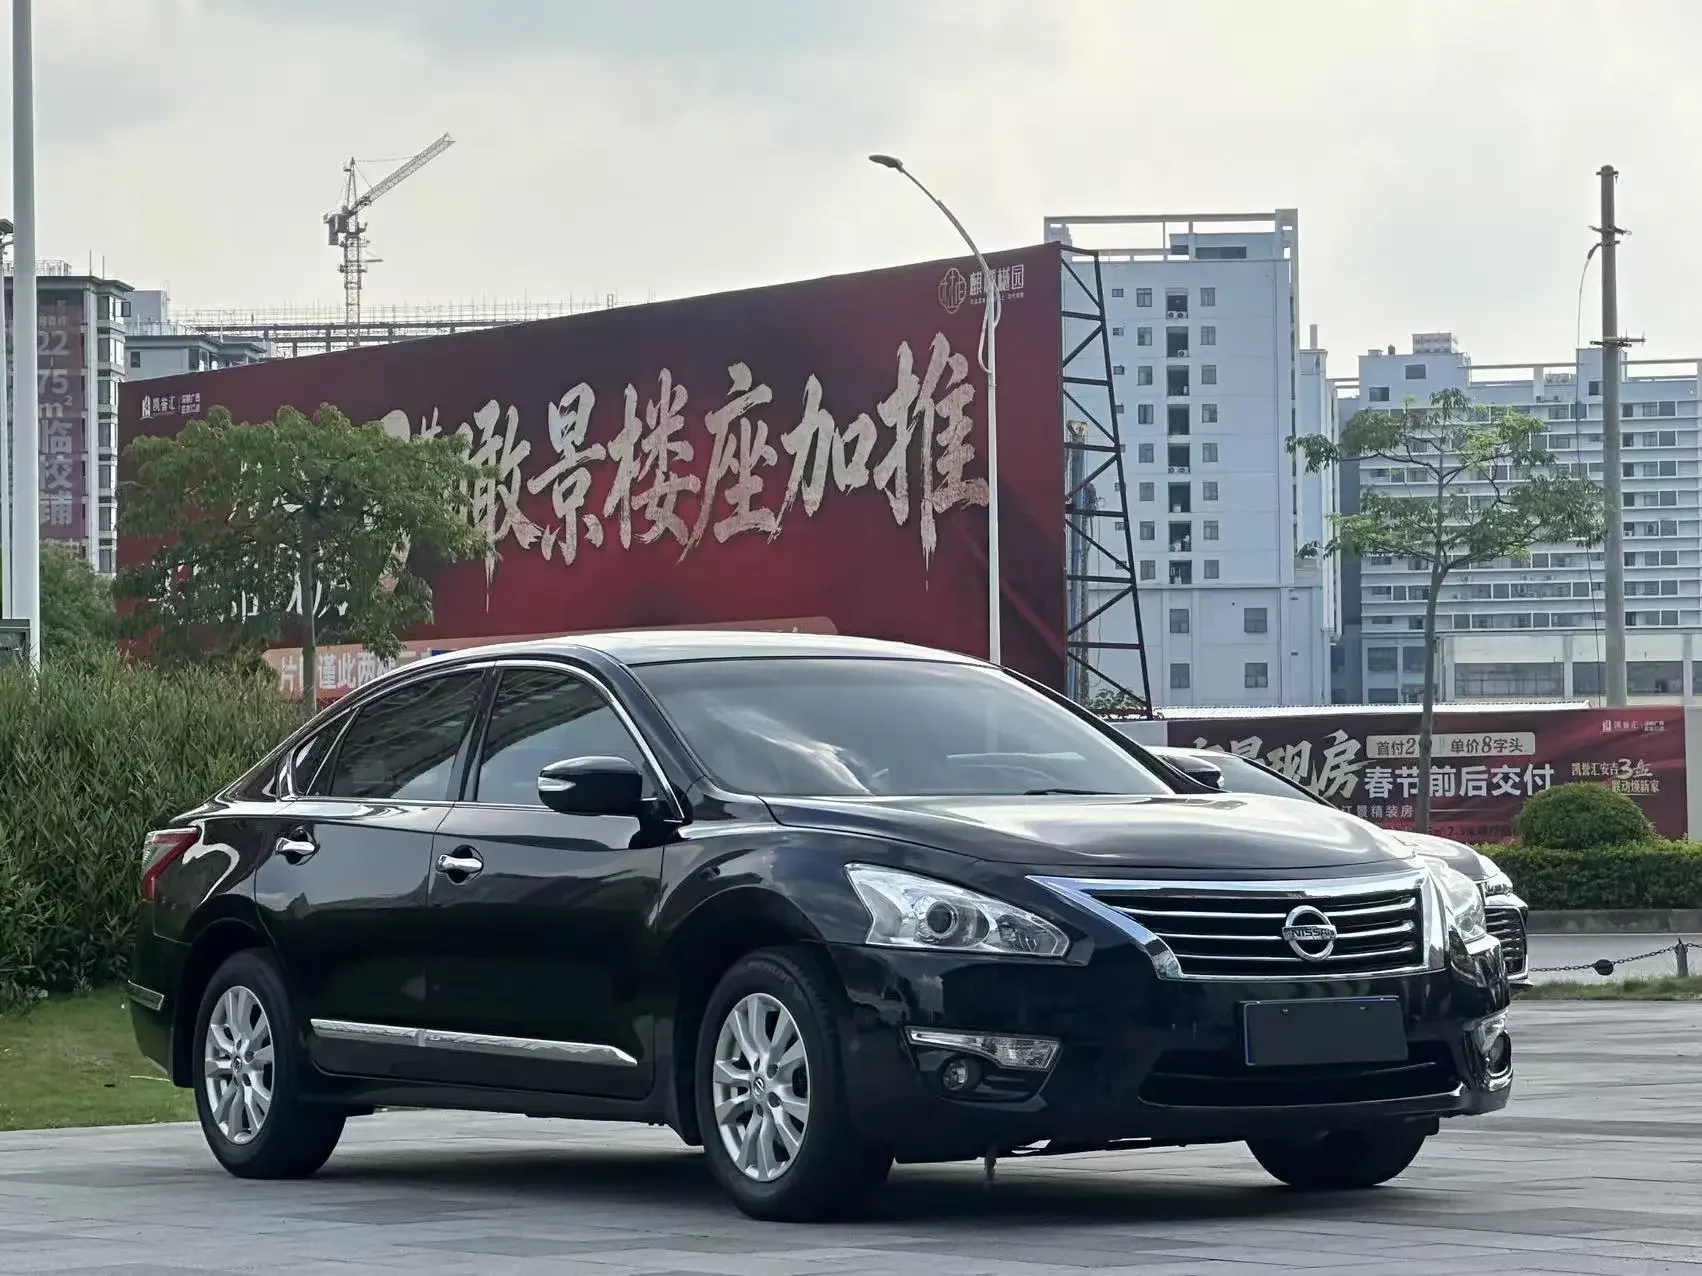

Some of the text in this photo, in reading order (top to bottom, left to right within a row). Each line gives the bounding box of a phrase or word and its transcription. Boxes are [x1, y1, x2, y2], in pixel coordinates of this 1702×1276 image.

[378, 331, 990, 600] 瞰景楼座加推
[1450, 735, 1525, 755] 单价8字头
[1364, 763, 1555, 799] 春节前后交付
[1290, 927, 1335, 938] NISSAN
